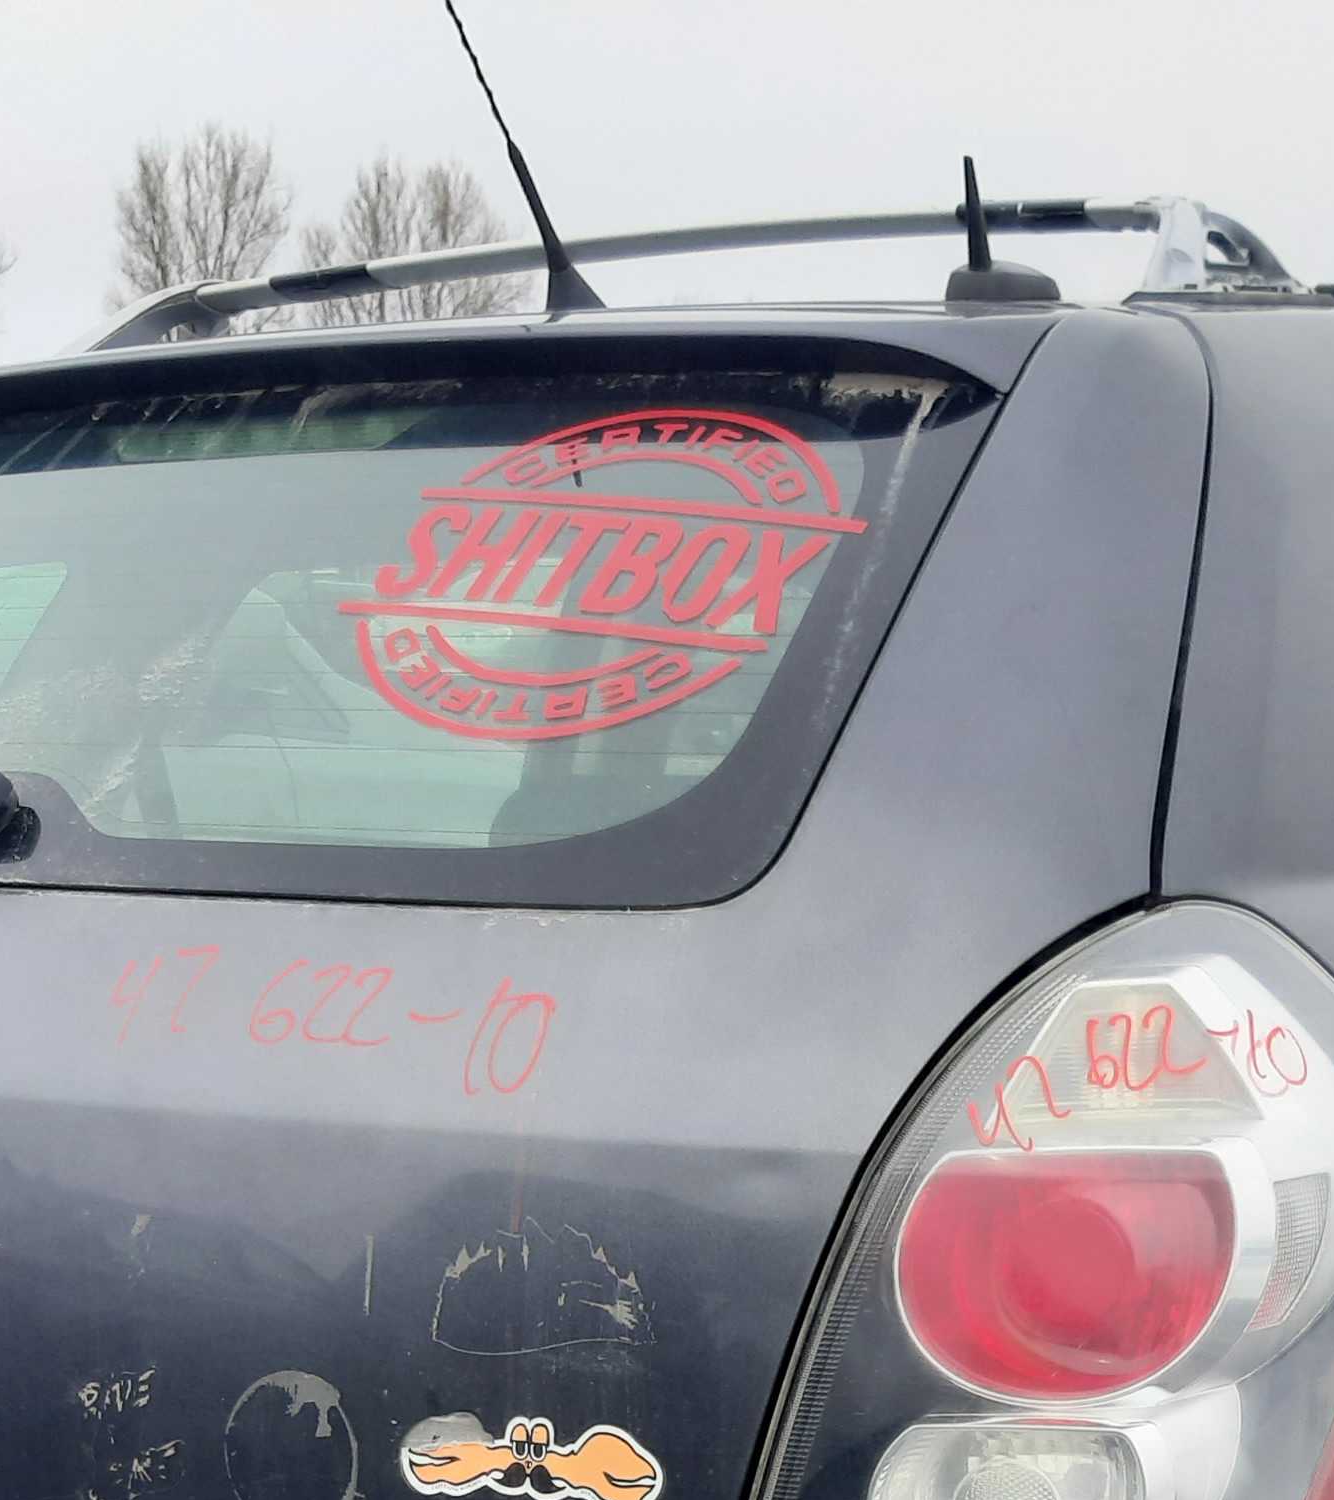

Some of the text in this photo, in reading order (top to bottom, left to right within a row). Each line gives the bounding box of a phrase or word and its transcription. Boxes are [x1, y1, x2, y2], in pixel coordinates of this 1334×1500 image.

[502, 421, 808, 504] CERTIFIED
[374, 504, 831, 634] SHITBOX
[384, 626, 693, 722] CERTIFIED
